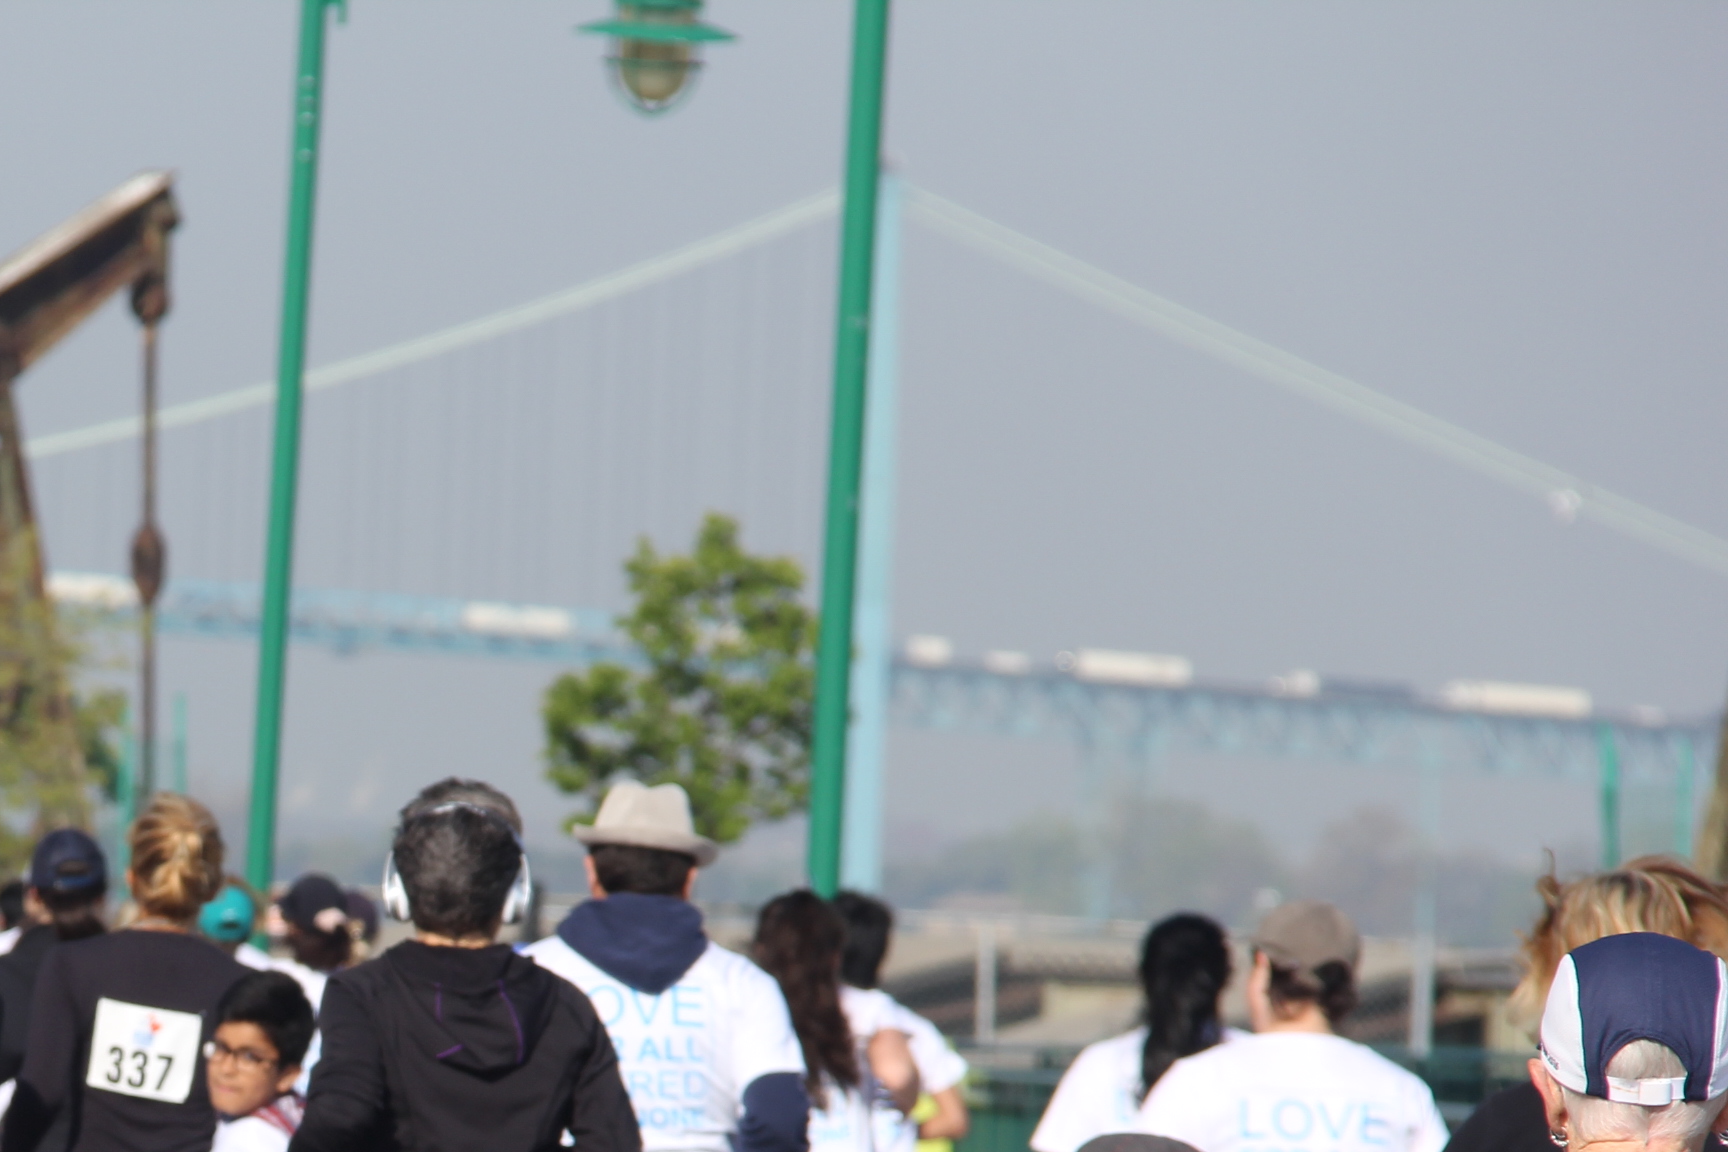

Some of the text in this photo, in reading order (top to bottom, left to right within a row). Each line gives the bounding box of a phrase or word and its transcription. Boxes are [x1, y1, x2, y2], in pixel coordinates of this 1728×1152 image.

[587, 982, 705, 1027] OVE
[106, 1045, 174, 1091] 337
[637, 1035, 705, 1063] ALL
[1237, 1098, 1390, 1146] LOVE
